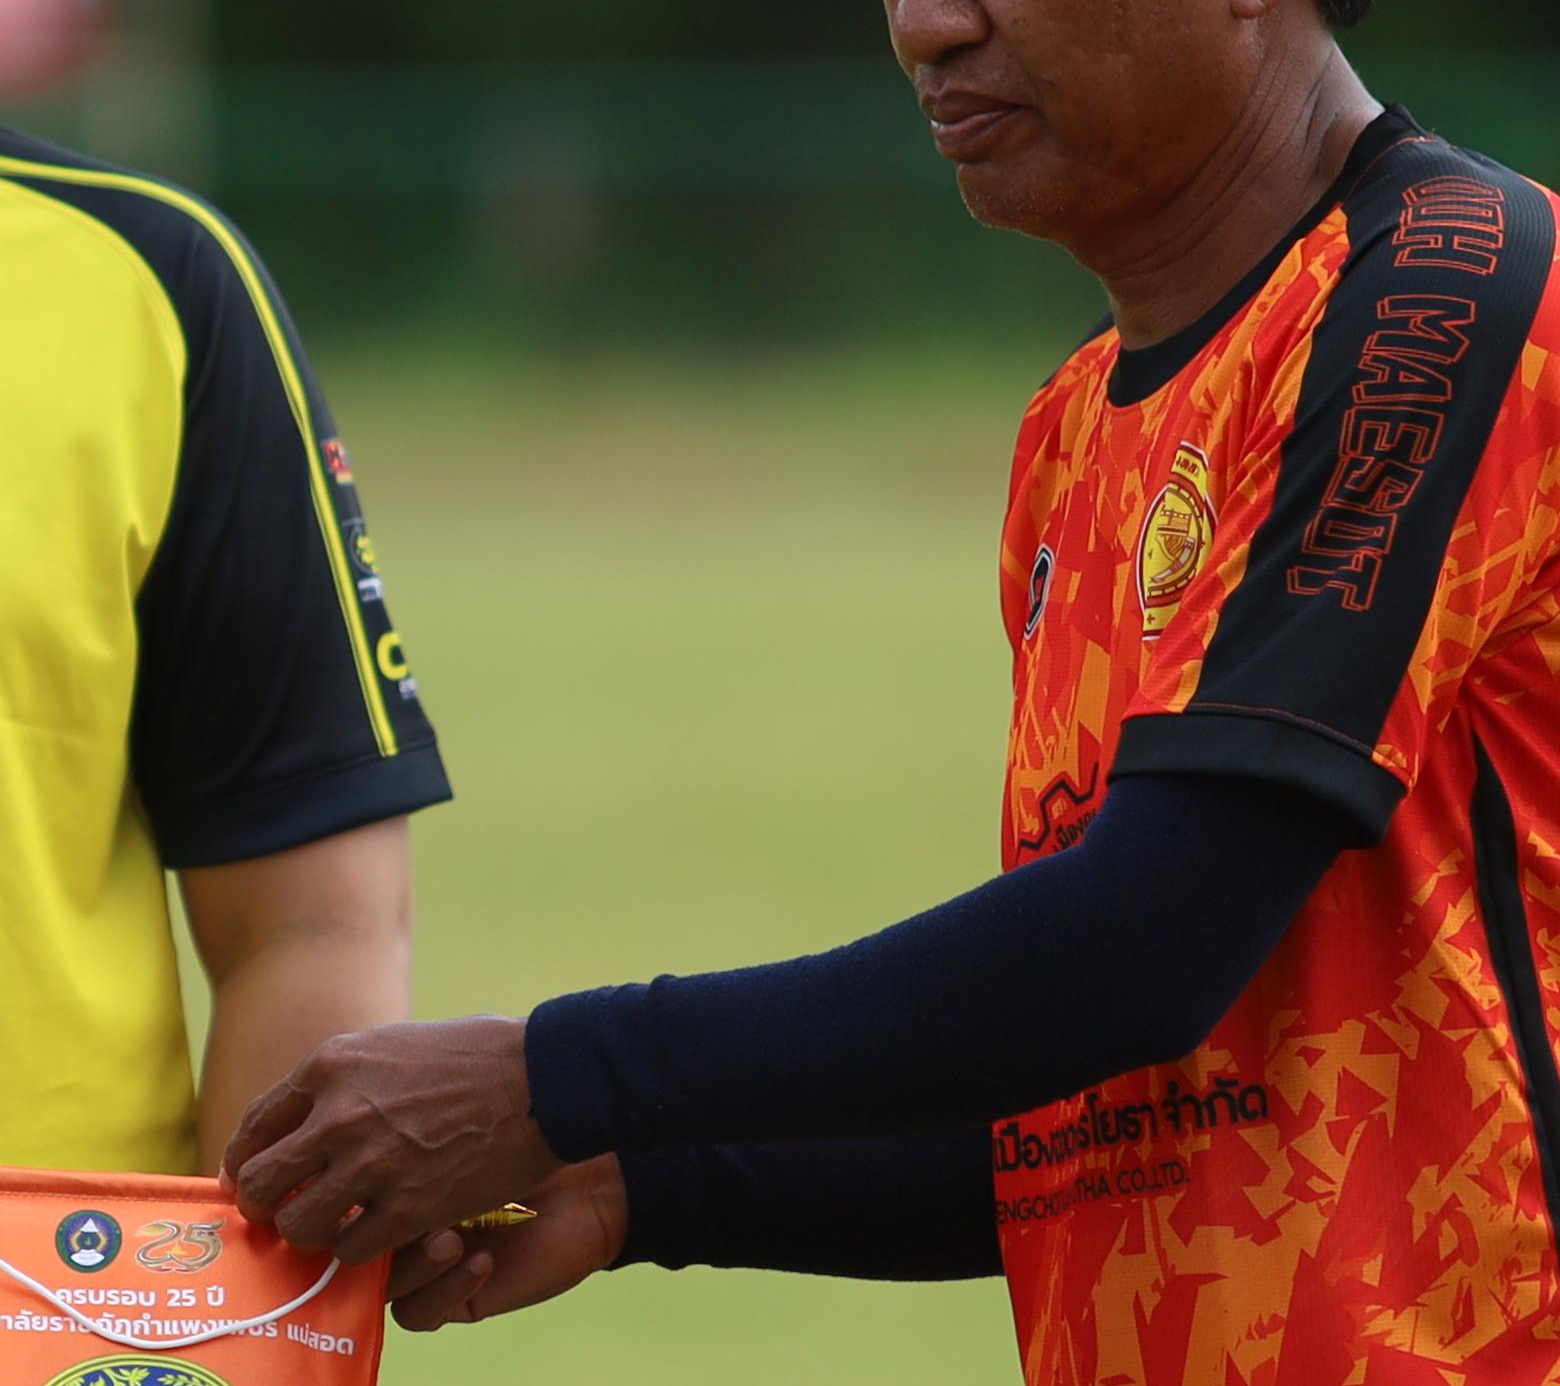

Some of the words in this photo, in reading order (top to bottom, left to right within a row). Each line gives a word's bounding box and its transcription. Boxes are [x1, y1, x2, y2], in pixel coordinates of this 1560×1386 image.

[1286, 293, 1476, 613] MAESOT
[1162, 1076, 1269, 1132] จำกัด
[166, 1287, 197, 1309] 25
[206, 1284, 225, 1308] ปี
[286, 1321, 355, 1356] แม่สอด
